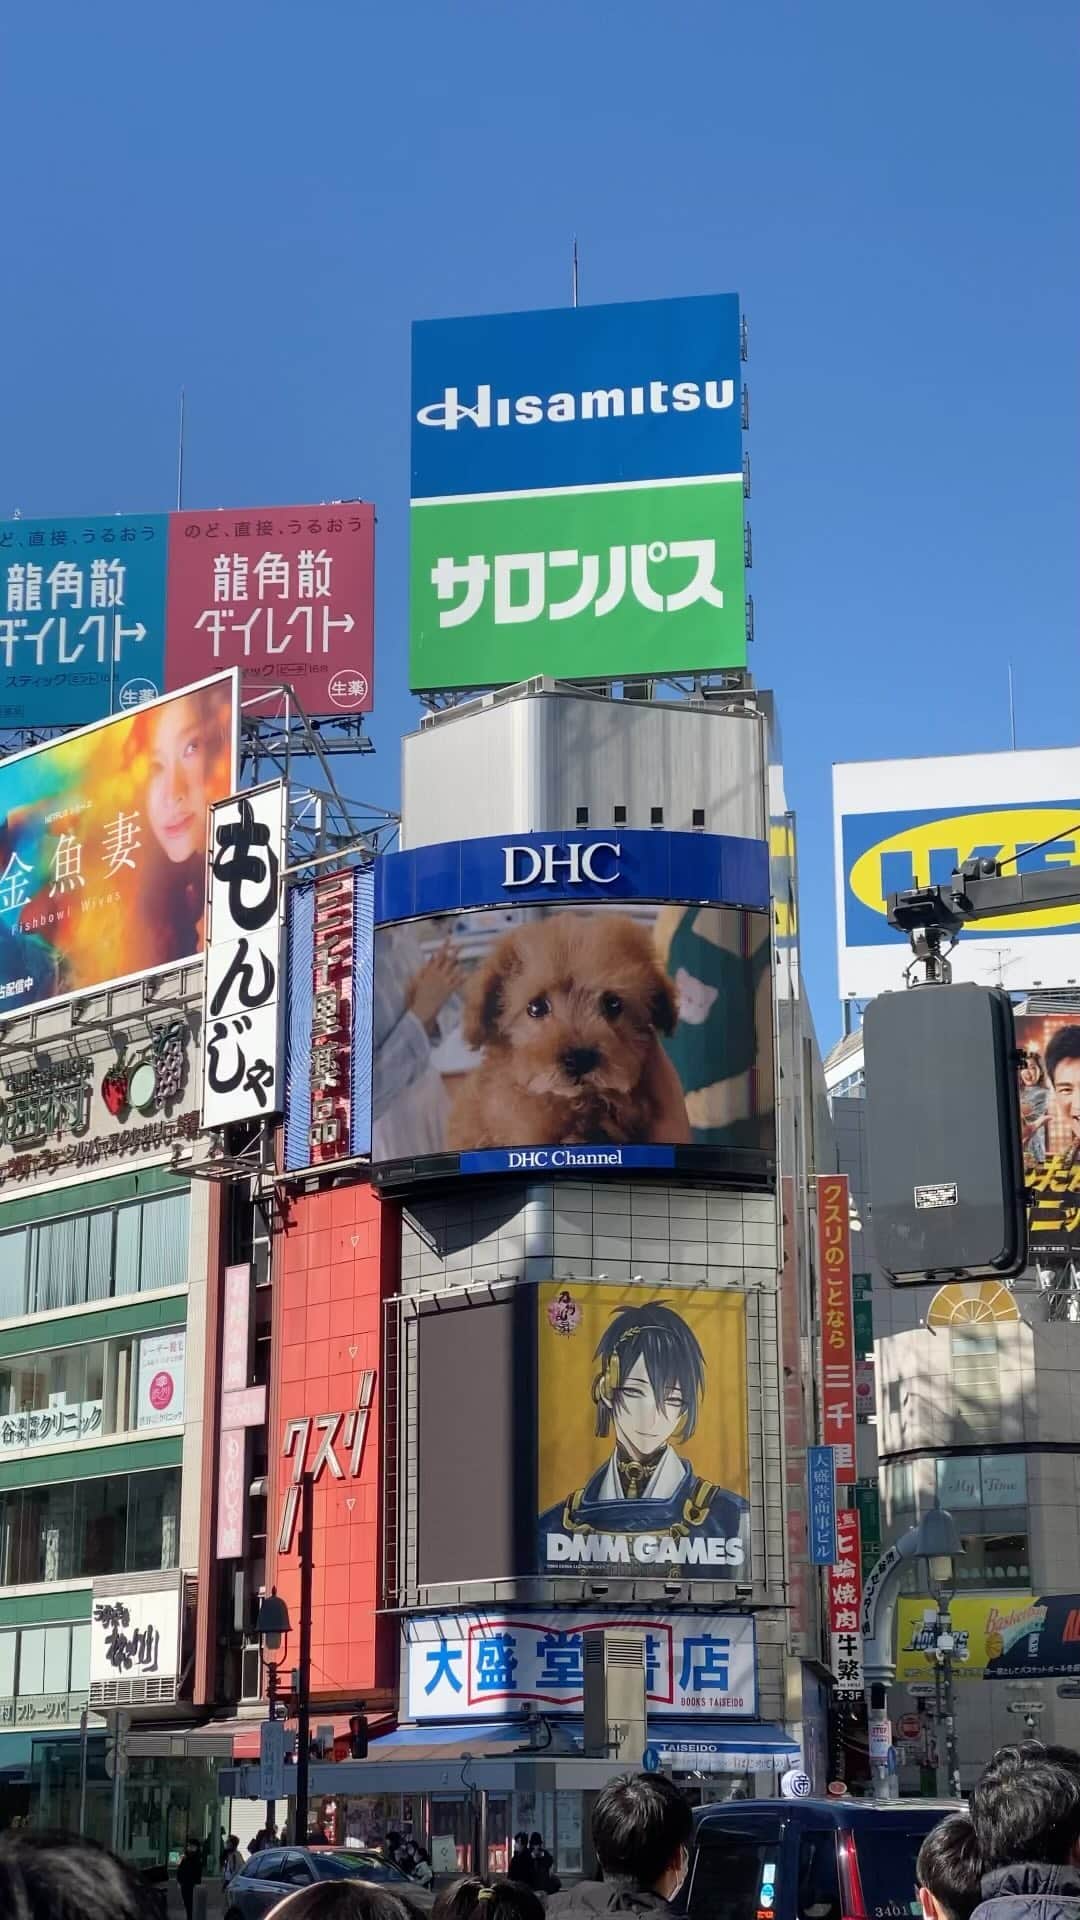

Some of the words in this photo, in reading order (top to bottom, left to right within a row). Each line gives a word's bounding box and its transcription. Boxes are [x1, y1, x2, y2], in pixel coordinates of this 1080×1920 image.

[416, 379, 734, 430] Hisamitsu
[7, 558, 126, 612] 龍角散
[213, 549, 332, 602] 龍角散
[431, 539, 724, 628] サロンパス
[0, 614, 146, 666] ダイレクト
[194, 605, 354, 656] ダイレクト
[331, 680, 366, 697] 生薬
[0, 811, 141, 913] 金魚妻
[501, 842, 621, 886] DHC
[206, 799, 278, 1108] もんじゃ
[508, 1150, 549, 1168] DHC
[551, 1149, 623, 1167] Channel
[823, 1185, 846, 1350] クスリのことなら
[279, 1369, 376, 1554] クスリ
[546, 1532, 631, 1563] DMM
[633, 1535, 746, 1565] GAMES
[838, 1634, 859, 1681] 牛繁
[681, 1697, 706, 1707] BOOKS
[710, 1697, 744, 1707] TAISEIDO
[661, 1743, 718, 1753] TAISEIDO
[874, 1906, 909, 1918] 3401
